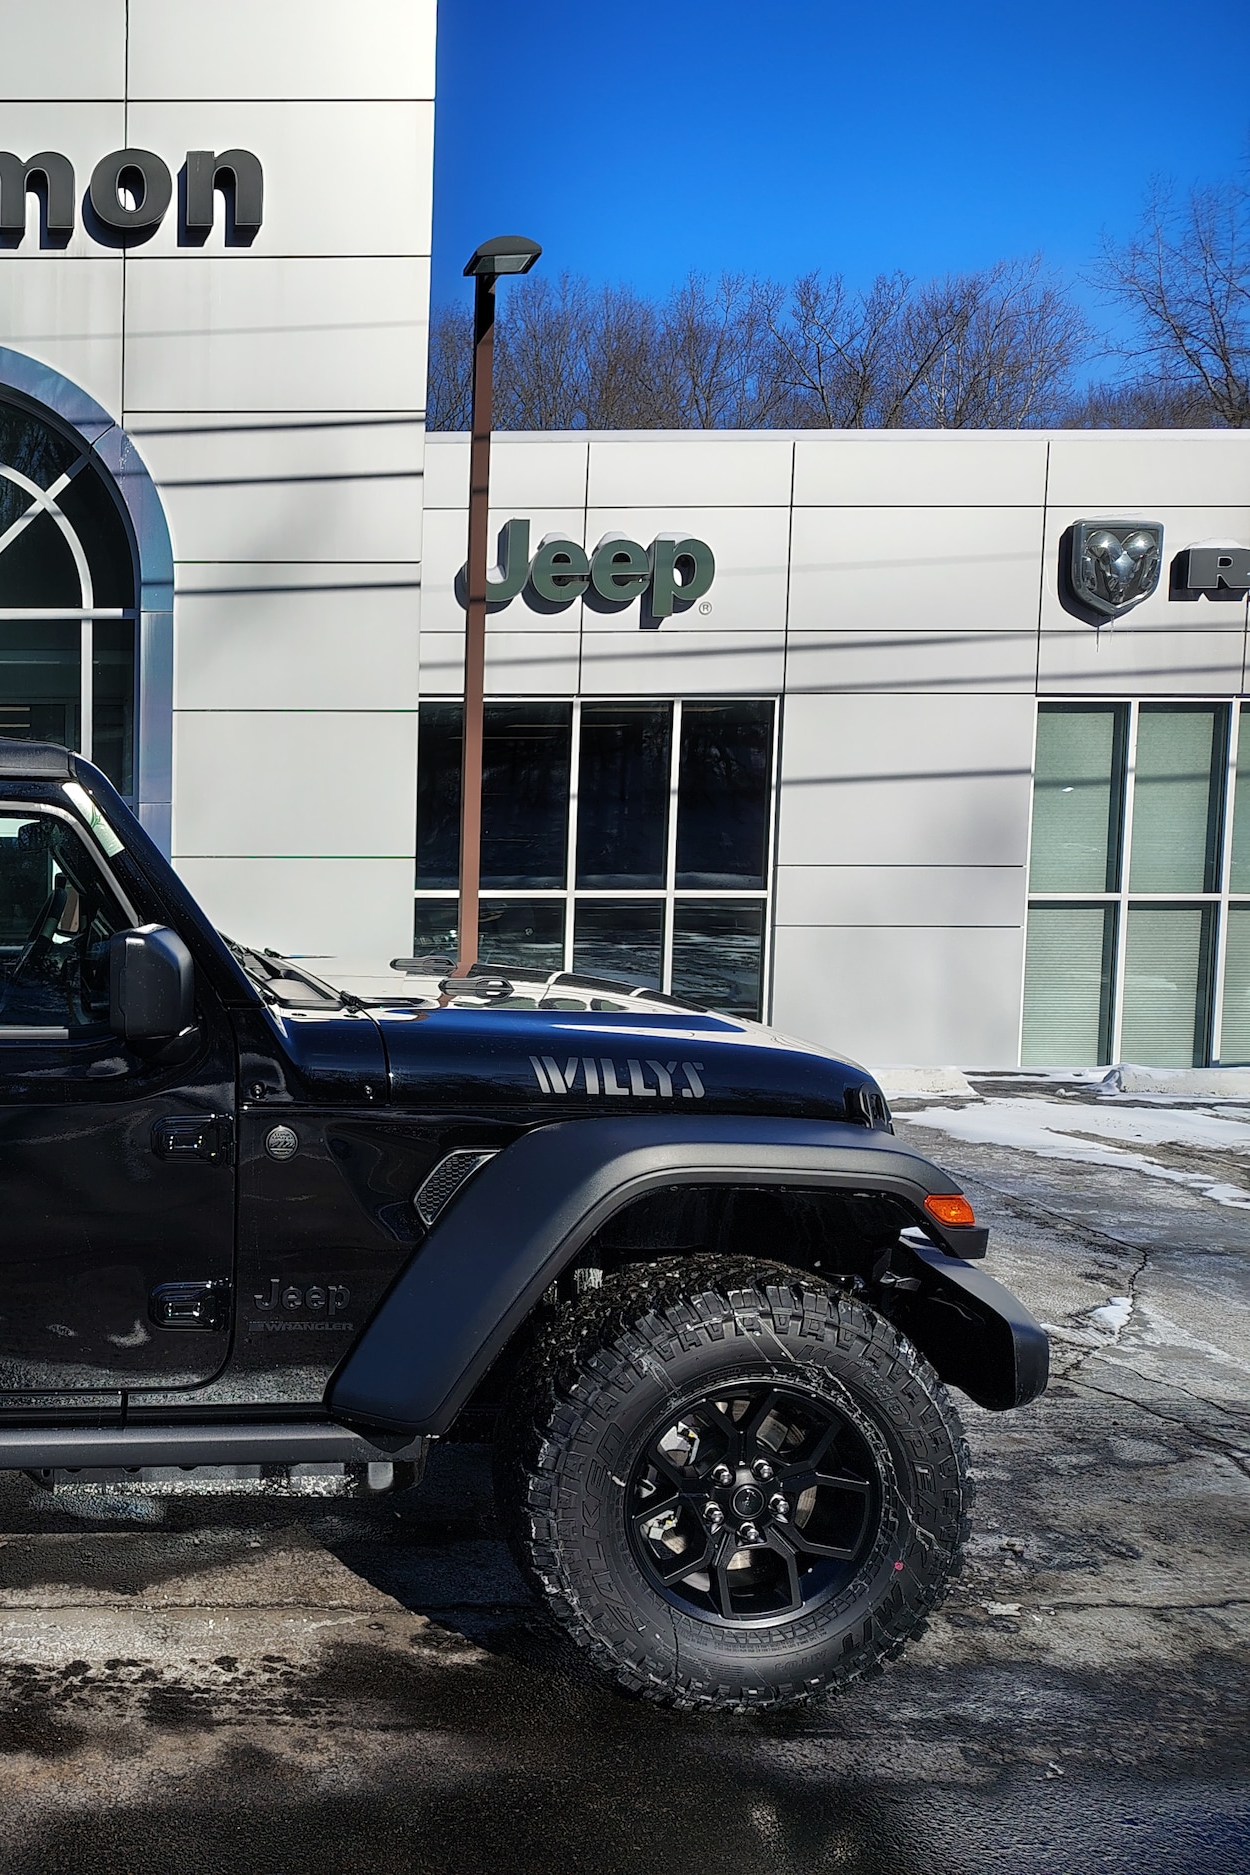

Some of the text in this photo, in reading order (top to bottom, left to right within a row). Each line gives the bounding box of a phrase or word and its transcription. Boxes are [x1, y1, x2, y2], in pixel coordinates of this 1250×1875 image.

[468, 518, 715, 617] Jeep
[1187, 547, 1250, 589] R
[528, 1055, 705, 1098] WILLYS
[253, 1278, 351, 1315] Jeep
[264, 1321, 355, 1332] WRANGLER
